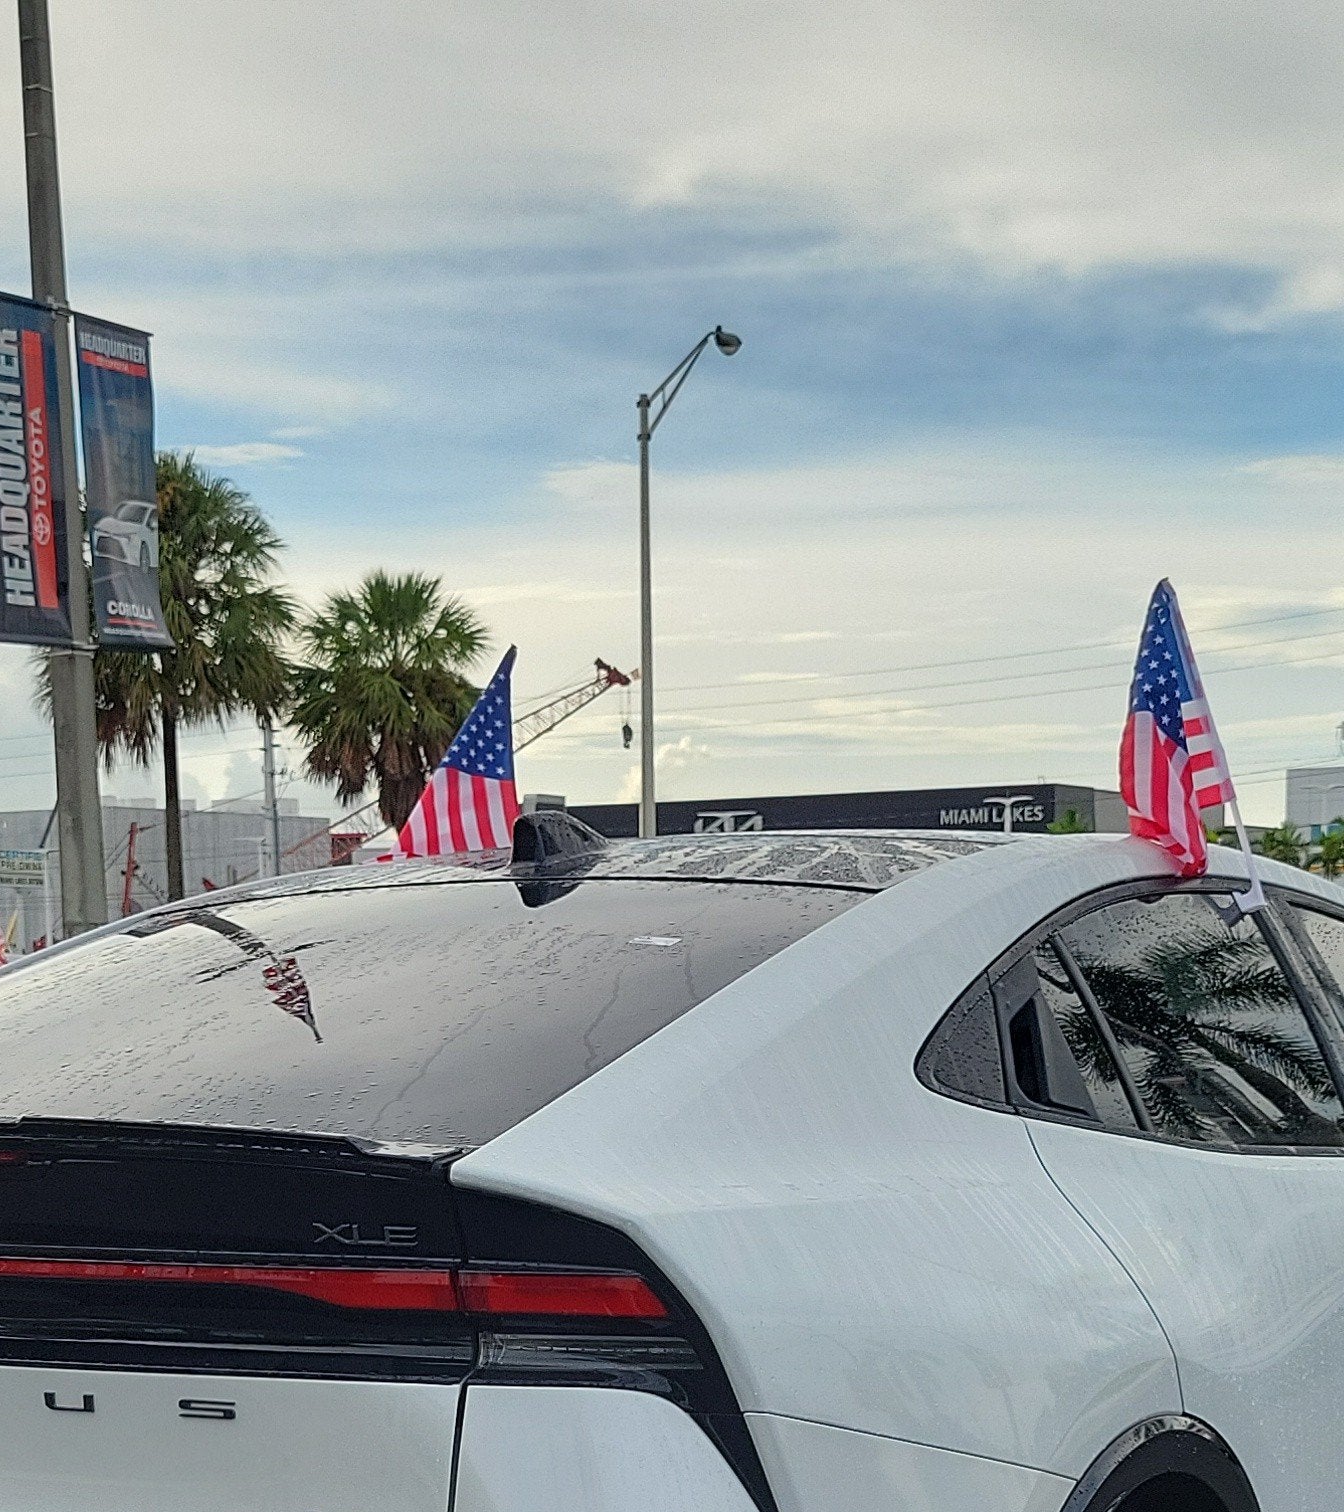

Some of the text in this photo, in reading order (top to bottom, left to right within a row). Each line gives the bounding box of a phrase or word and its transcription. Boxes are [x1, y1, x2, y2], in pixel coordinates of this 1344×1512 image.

[28, 407, 52, 511] TOYOTA
[939, 804, 1045, 826] MIAMI LKES
[312, 1222, 418, 1246] XLE
